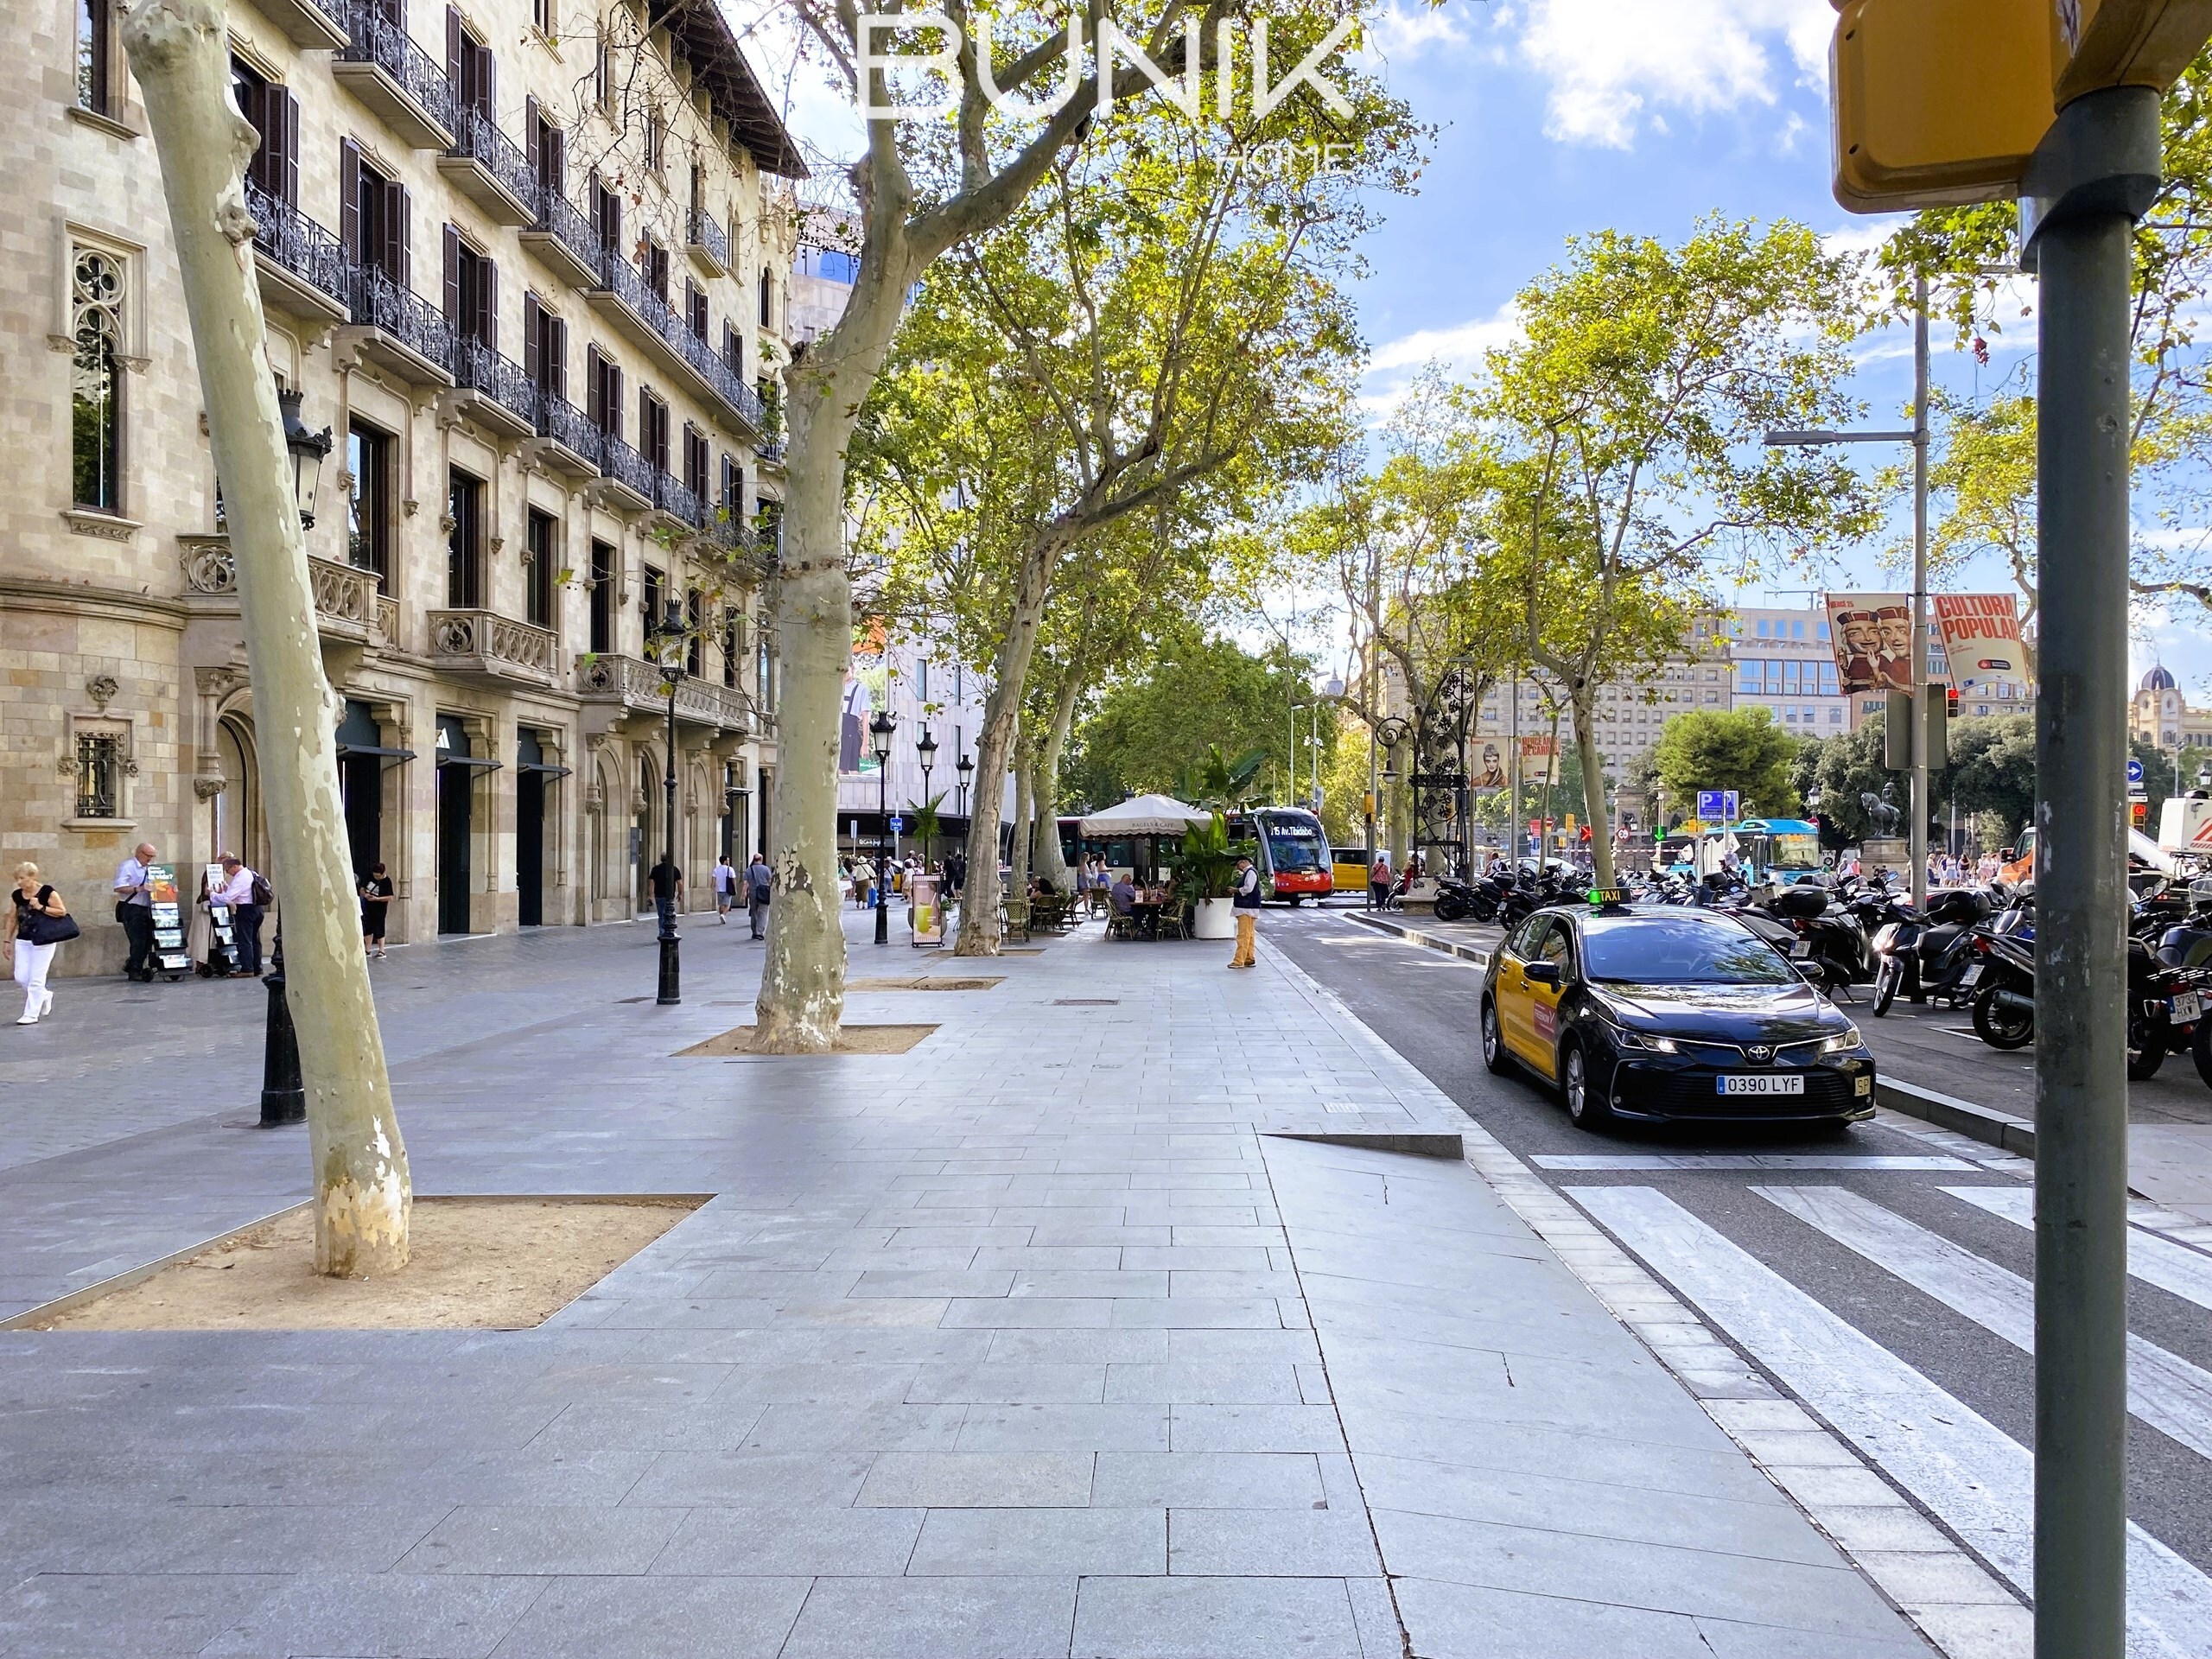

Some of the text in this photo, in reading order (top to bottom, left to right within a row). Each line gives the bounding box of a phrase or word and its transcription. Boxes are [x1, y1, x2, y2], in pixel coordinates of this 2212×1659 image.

[1936, 595, 2014, 619] CULTURA
[1942, 617, 2019, 644] POPULAR
[1701, 793, 1713, 809] P
[1599, 890, 1621, 901] TAXI
[2175, 993, 2196, 1007] 3732
[1728, 1077, 1800, 1092] 0390 LYF
[1857, 1077, 1869, 1095] SP
